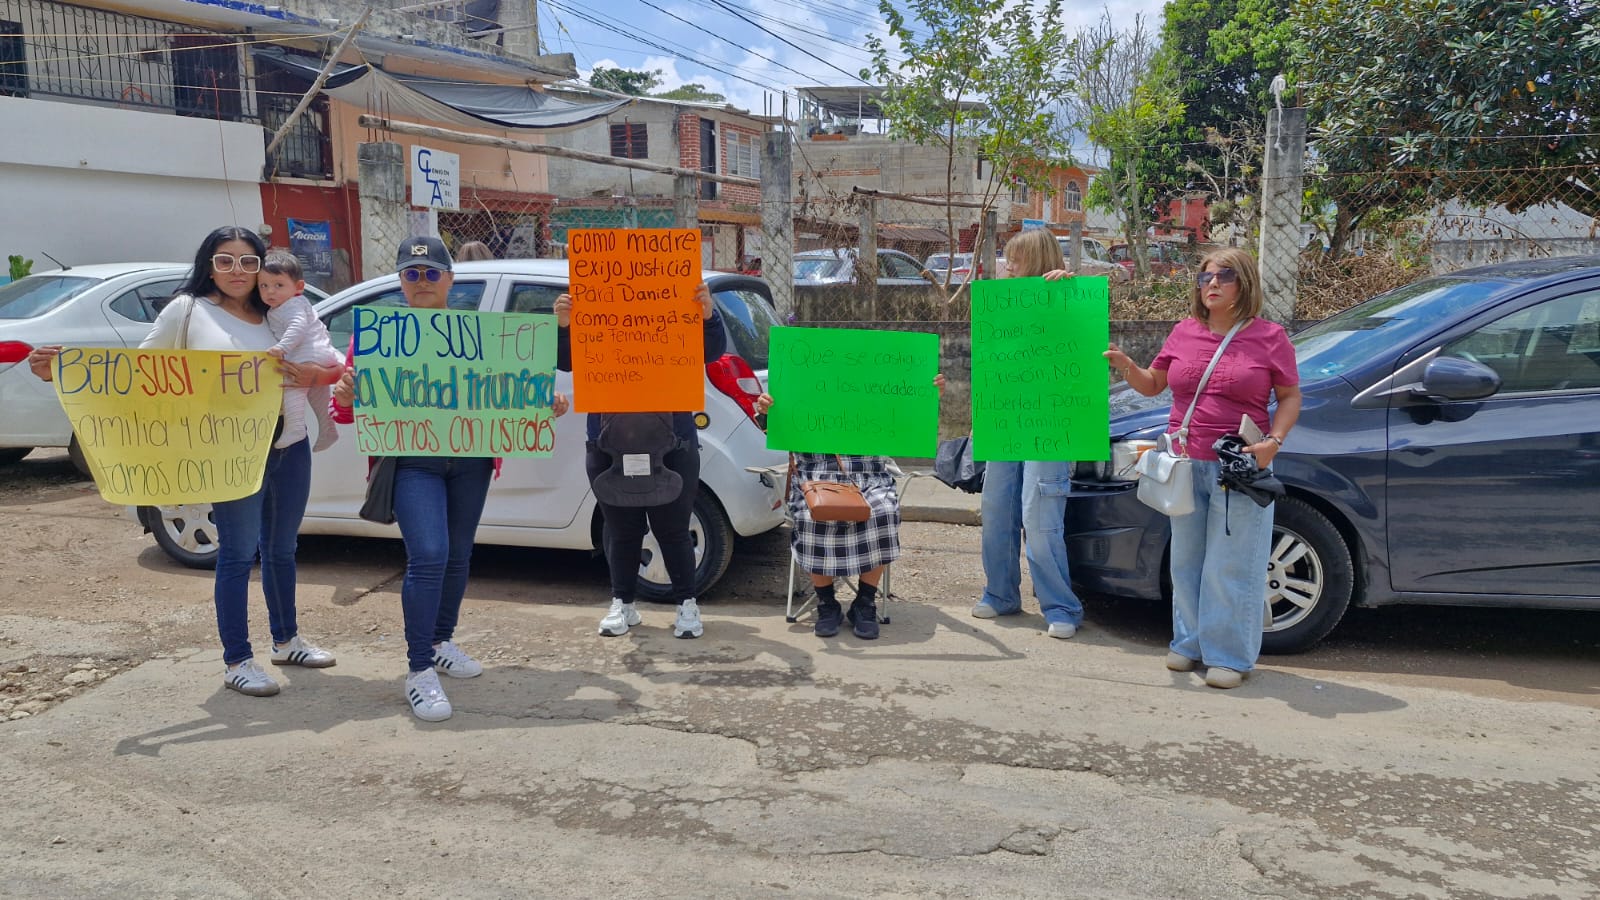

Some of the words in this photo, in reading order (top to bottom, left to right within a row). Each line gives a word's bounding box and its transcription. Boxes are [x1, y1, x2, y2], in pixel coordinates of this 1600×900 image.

[574, 259, 622, 283] exijo
[626, 258, 692, 280] justicia
[622, 310, 677, 333] amiga
[498, 316, 549, 361] Fer
[577, 331, 604, 349] que
[679, 334, 685, 350] y
[1055, 341, 1079, 356] en
[670, 354, 696, 366] son
[845, 351, 868, 366] se
[220, 354, 269, 395] Fer
[584, 368, 643, 384] inocentes
[815, 380, 827, 393] a
[70, 404, 168, 447] amilia
[355, 414, 440, 453] Estamos
[449, 416, 483, 453] con
[490, 413, 556, 453] ustedes
[1002, 436, 1022, 455] de
[99, 458, 170, 496] tamos
[177, 457, 215, 494] con
